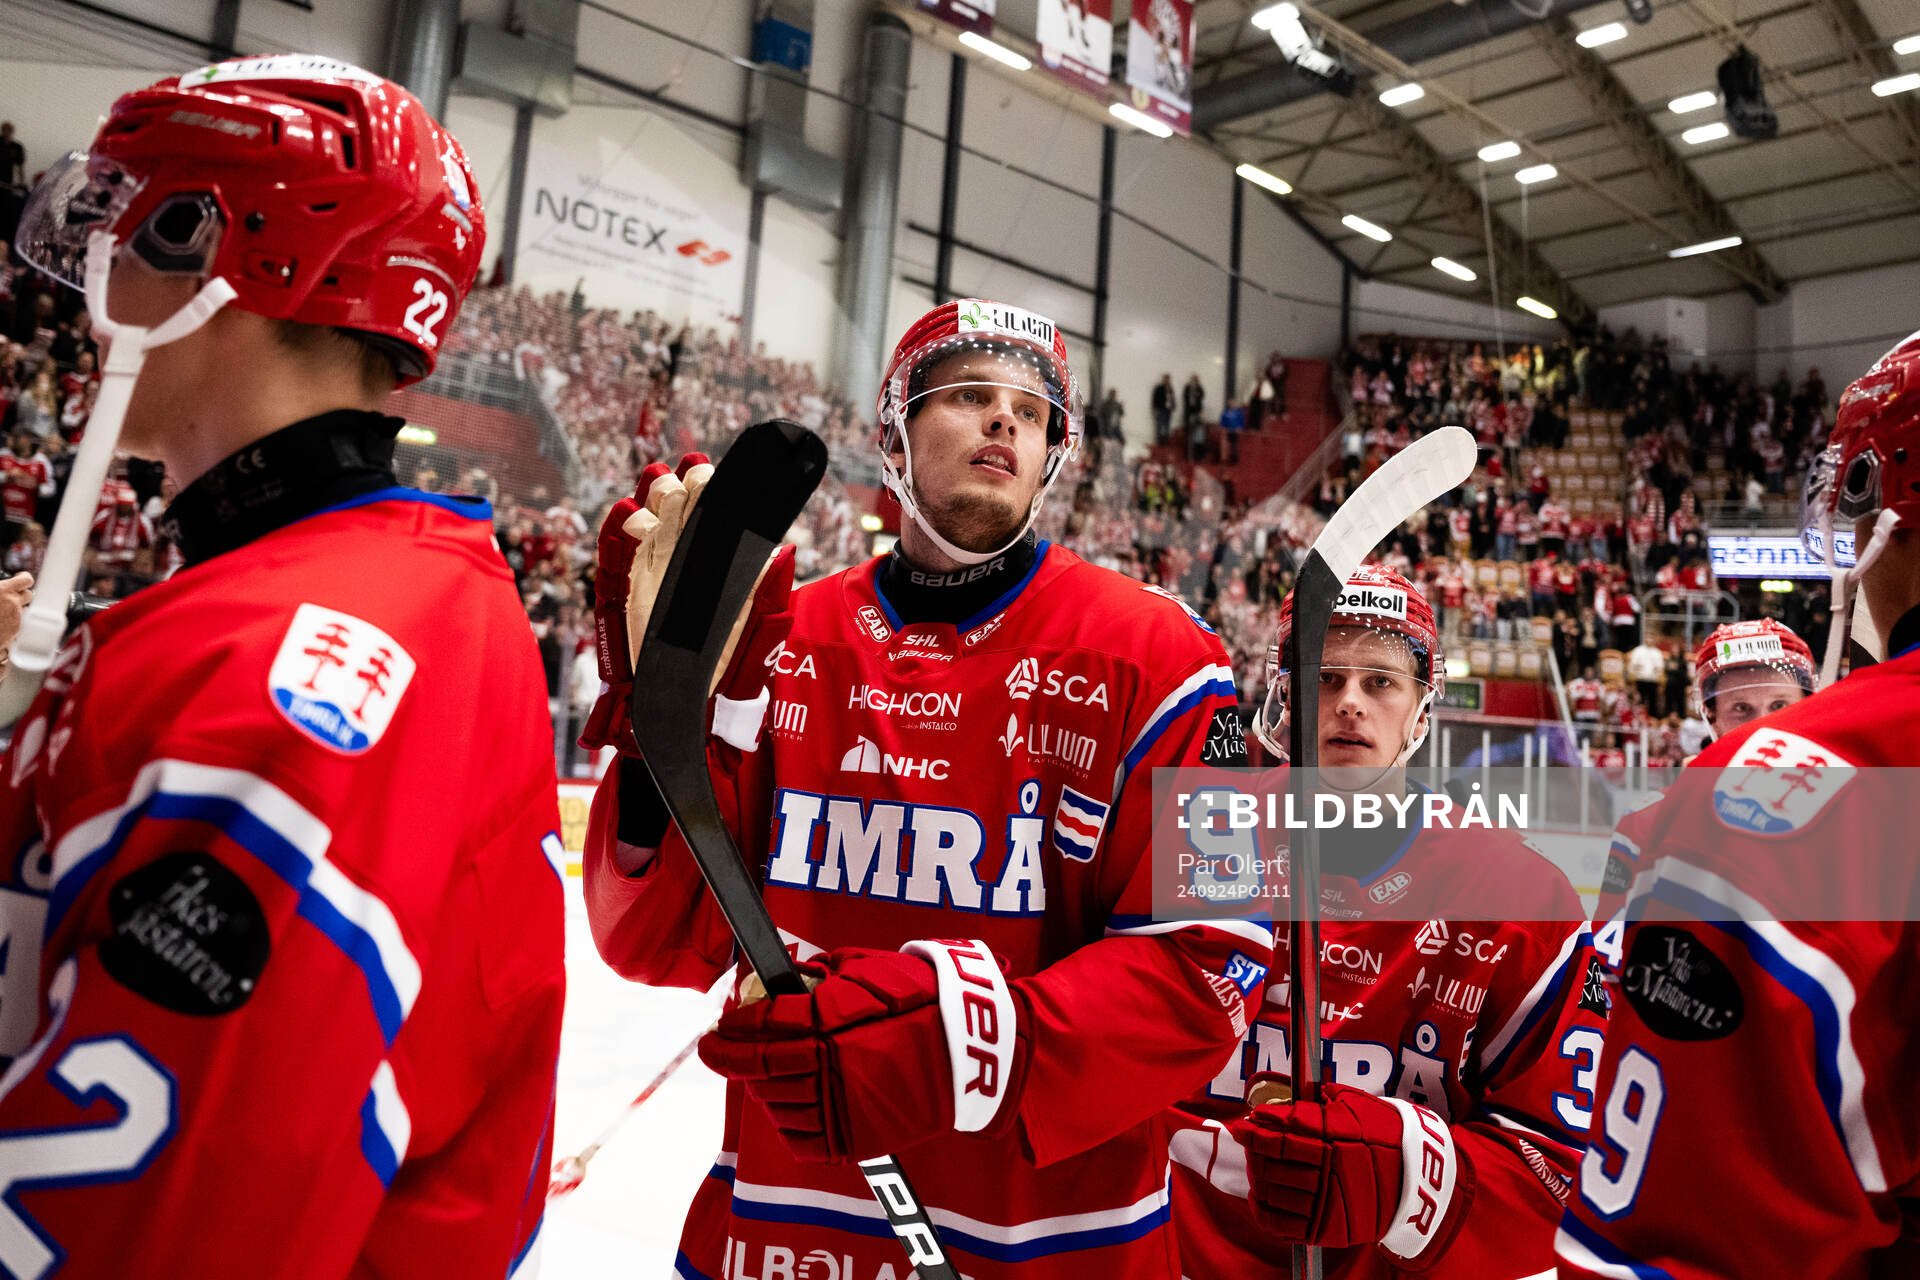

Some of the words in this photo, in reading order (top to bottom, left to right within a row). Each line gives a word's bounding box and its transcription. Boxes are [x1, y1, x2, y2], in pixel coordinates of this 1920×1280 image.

[535, 187, 667, 254] NOTEX
[403, 278, 448, 346] 22
[911, 556, 1005, 587] BAUER
[1333, 590, 1403, 614] pelkoll
[860, 608, 888, 640] EAB
[902, 634, 940, 648] SHL
[598, 617, 613, 676] LUNDMARK
[897, 649, 954, 662] BAUER
[848, 684, 962, 718] HIGHCON
[1042, 669, 1109, 712] SCA
[919, 721, 957, 732] INSTALCO
[1027, 723, 1098, 771] LILIUM
[883, 752, 951, 781] NHC
[768, 780, 1047, 914] IMRÅ
[1371, 874, 1409, 901] EAB
[1454, 932, 1508, 965] SCA
[1592, 903, 1625, 969] 4
[1201, 968, 1241, 1007] ALLS
[1225, 953, 1266, 990] ST
[1341, 971, 1378, 986] INSTALCO
[1434, 974, 1488, 1014] LILIU
[1553, 1026, 1604, 1132] 3
[1581, 1045, 1666, 1220] 9
[858, 1153, 946, 1268] PR
